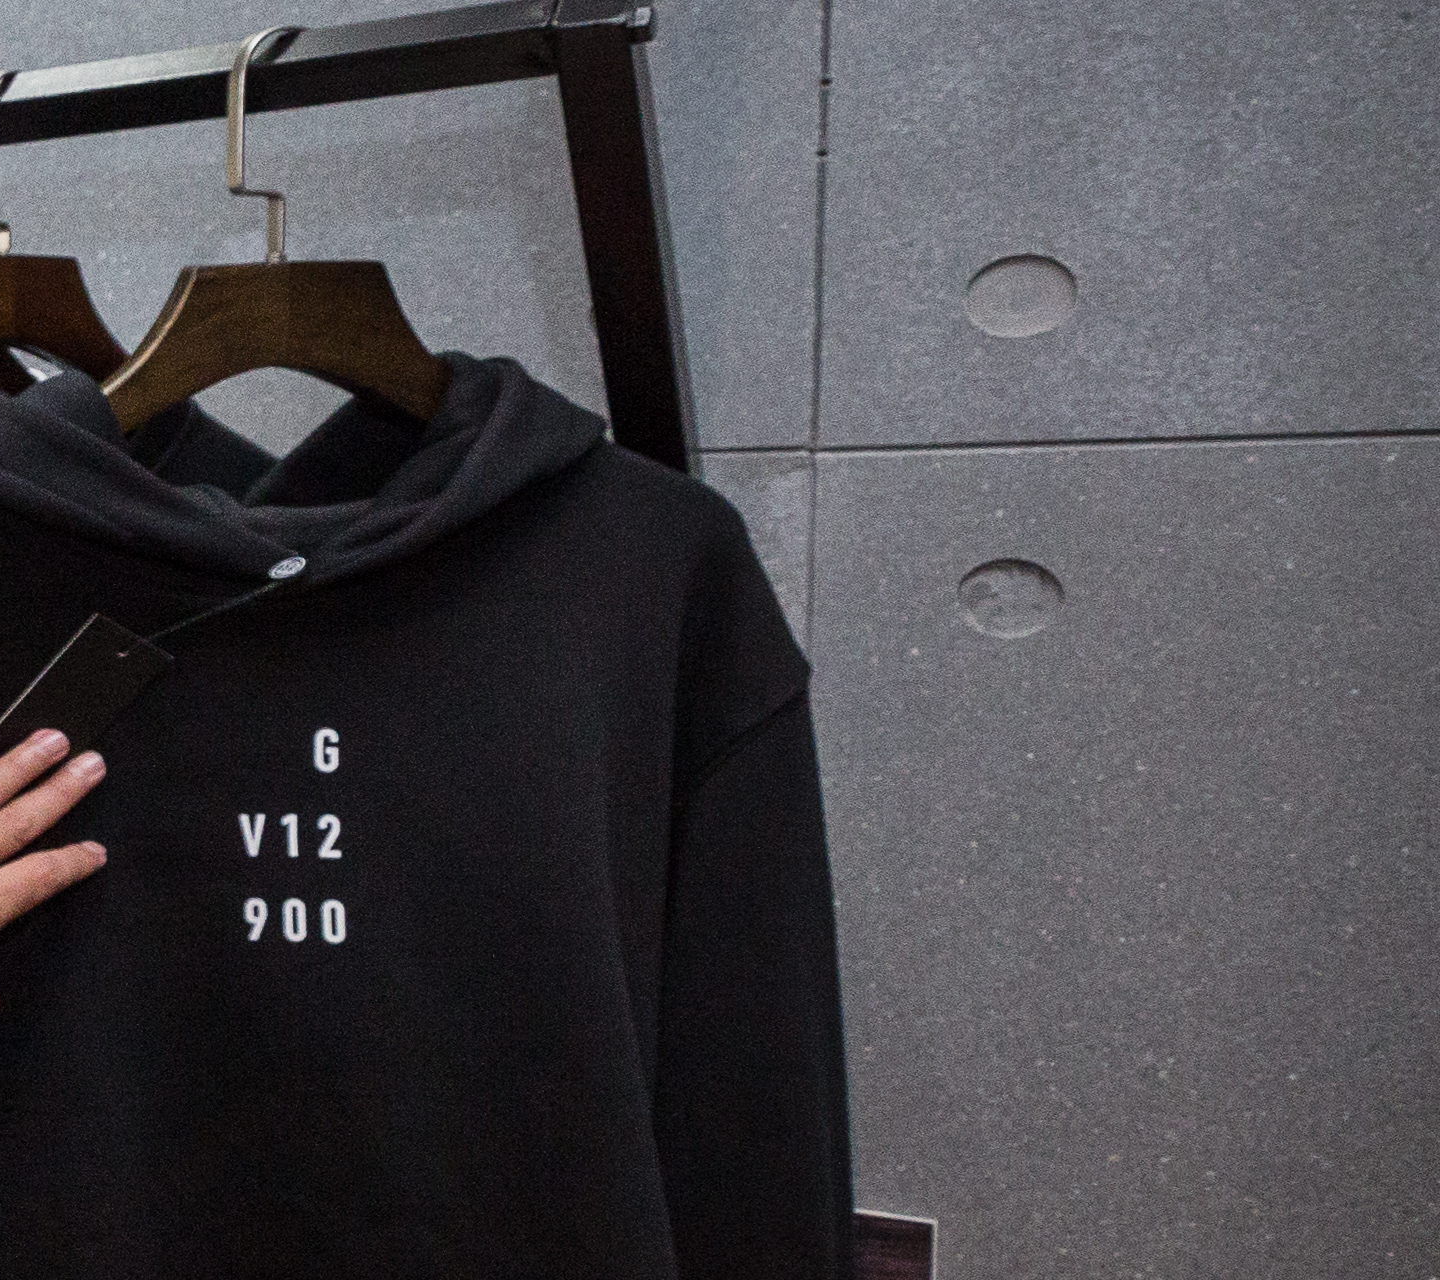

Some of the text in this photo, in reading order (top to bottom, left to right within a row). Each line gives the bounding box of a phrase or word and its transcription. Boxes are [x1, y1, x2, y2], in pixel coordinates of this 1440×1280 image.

[313, 727, 340, 773] G
[238, 813, 343, 860] V12
[243, 897, 347, 945] 900
